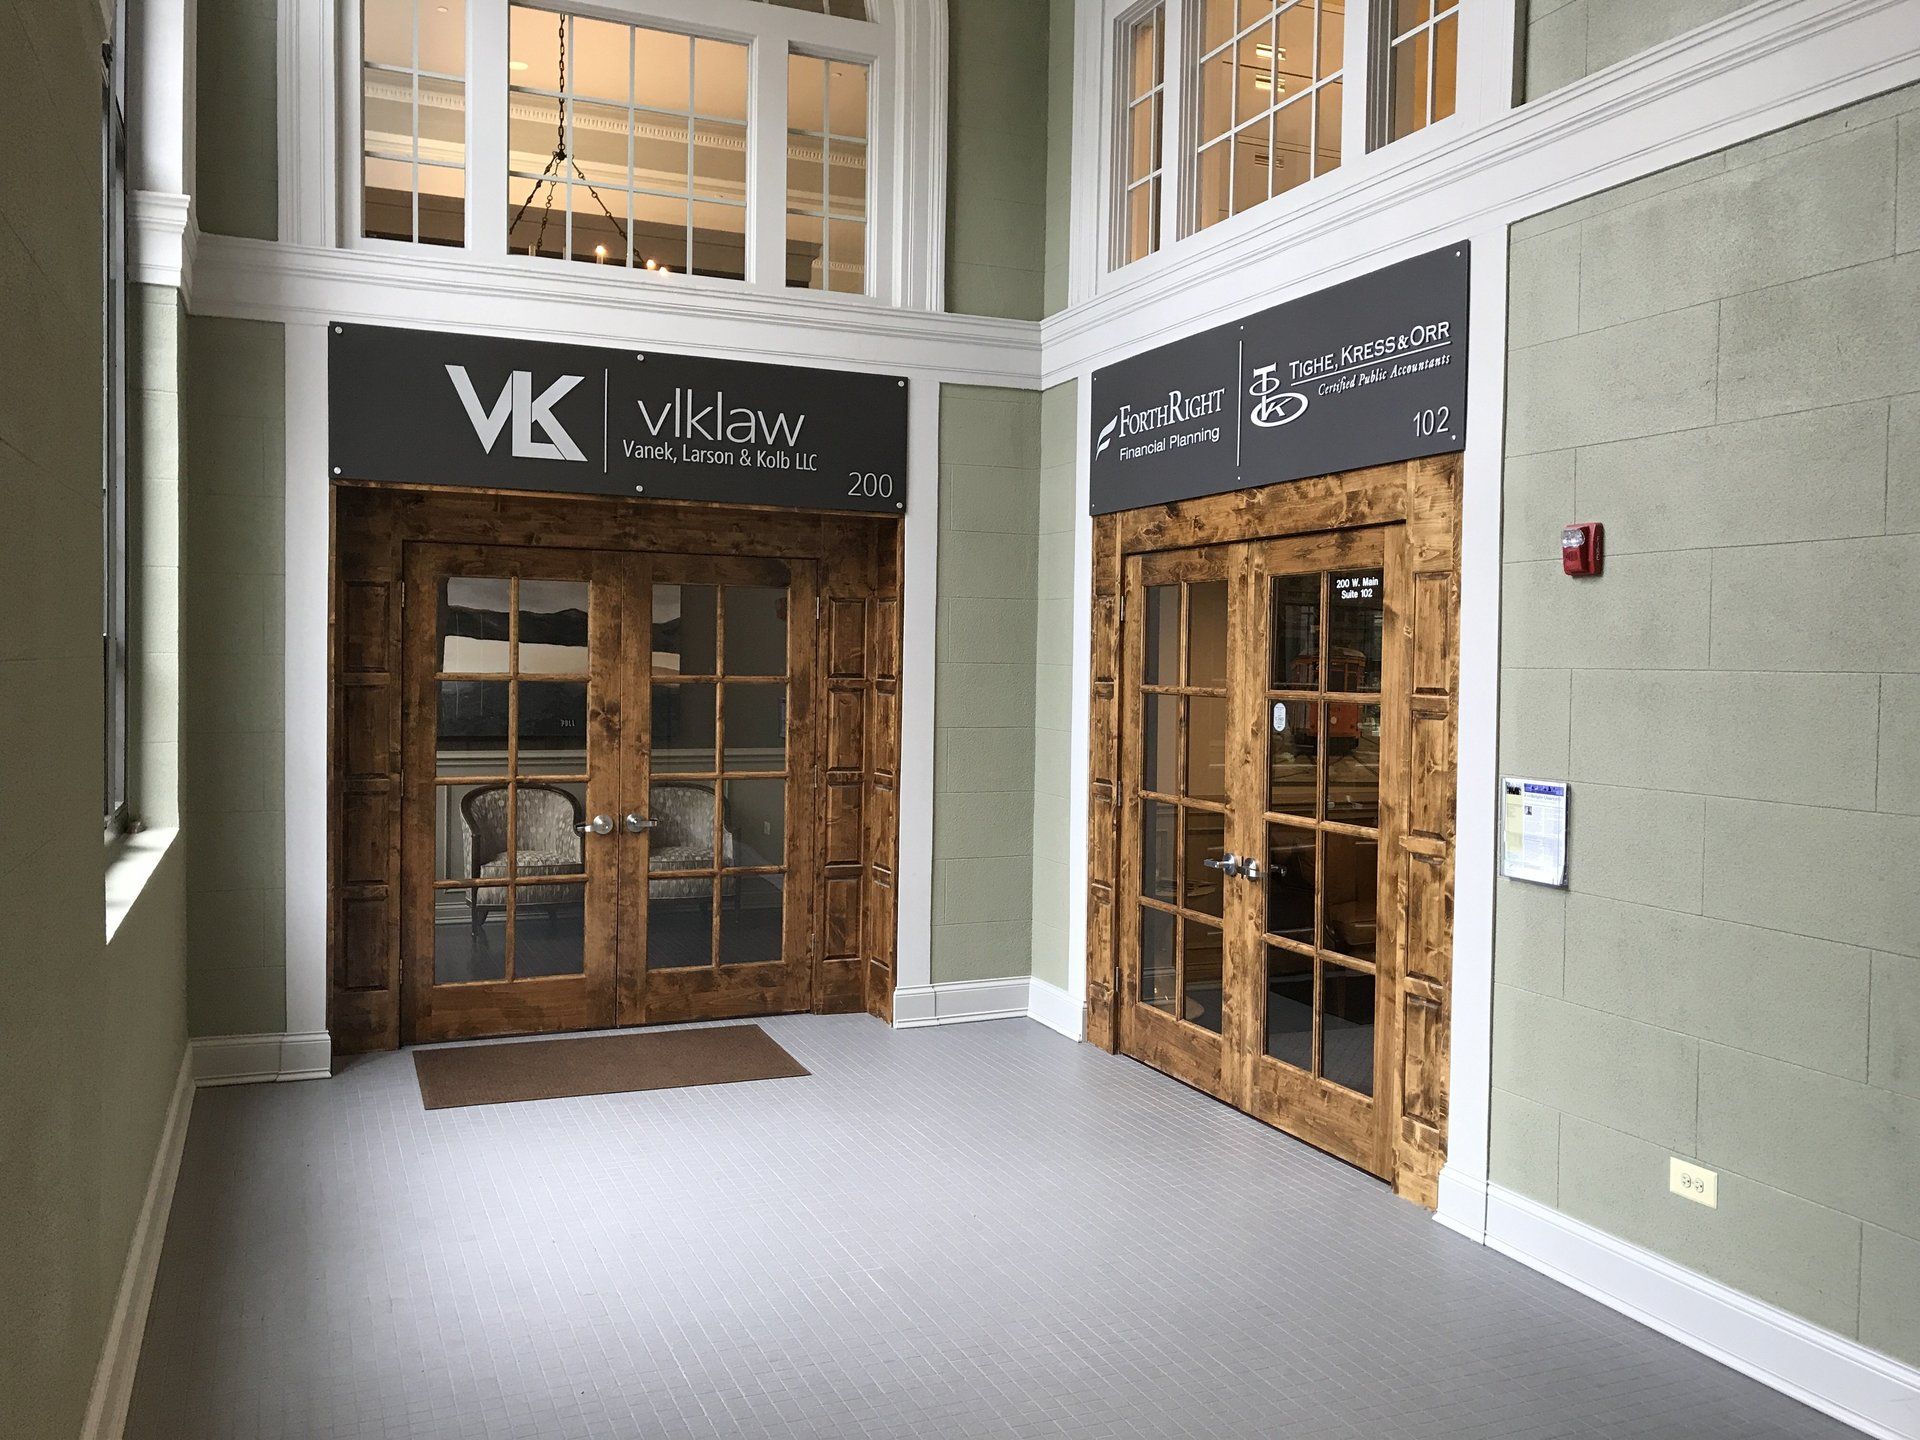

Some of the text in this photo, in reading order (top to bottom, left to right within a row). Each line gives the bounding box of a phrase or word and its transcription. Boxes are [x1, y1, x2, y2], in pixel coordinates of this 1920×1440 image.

[1318, 354, 1450, 396] Certified Public Accountants
[637, 387, 805, 447] vlklaw
[1413, 406, 1449, 437] 102
[622, 439, 818, 471] Vanek, Larson & Kolb LLC
[1120, 427, 1220, 461] Financial Planning
[847, 472, 893, 498] 200
[1336, 577, 1379, 588] 200 W. Main
[1341, 588, 1373, 599] Suite 102
